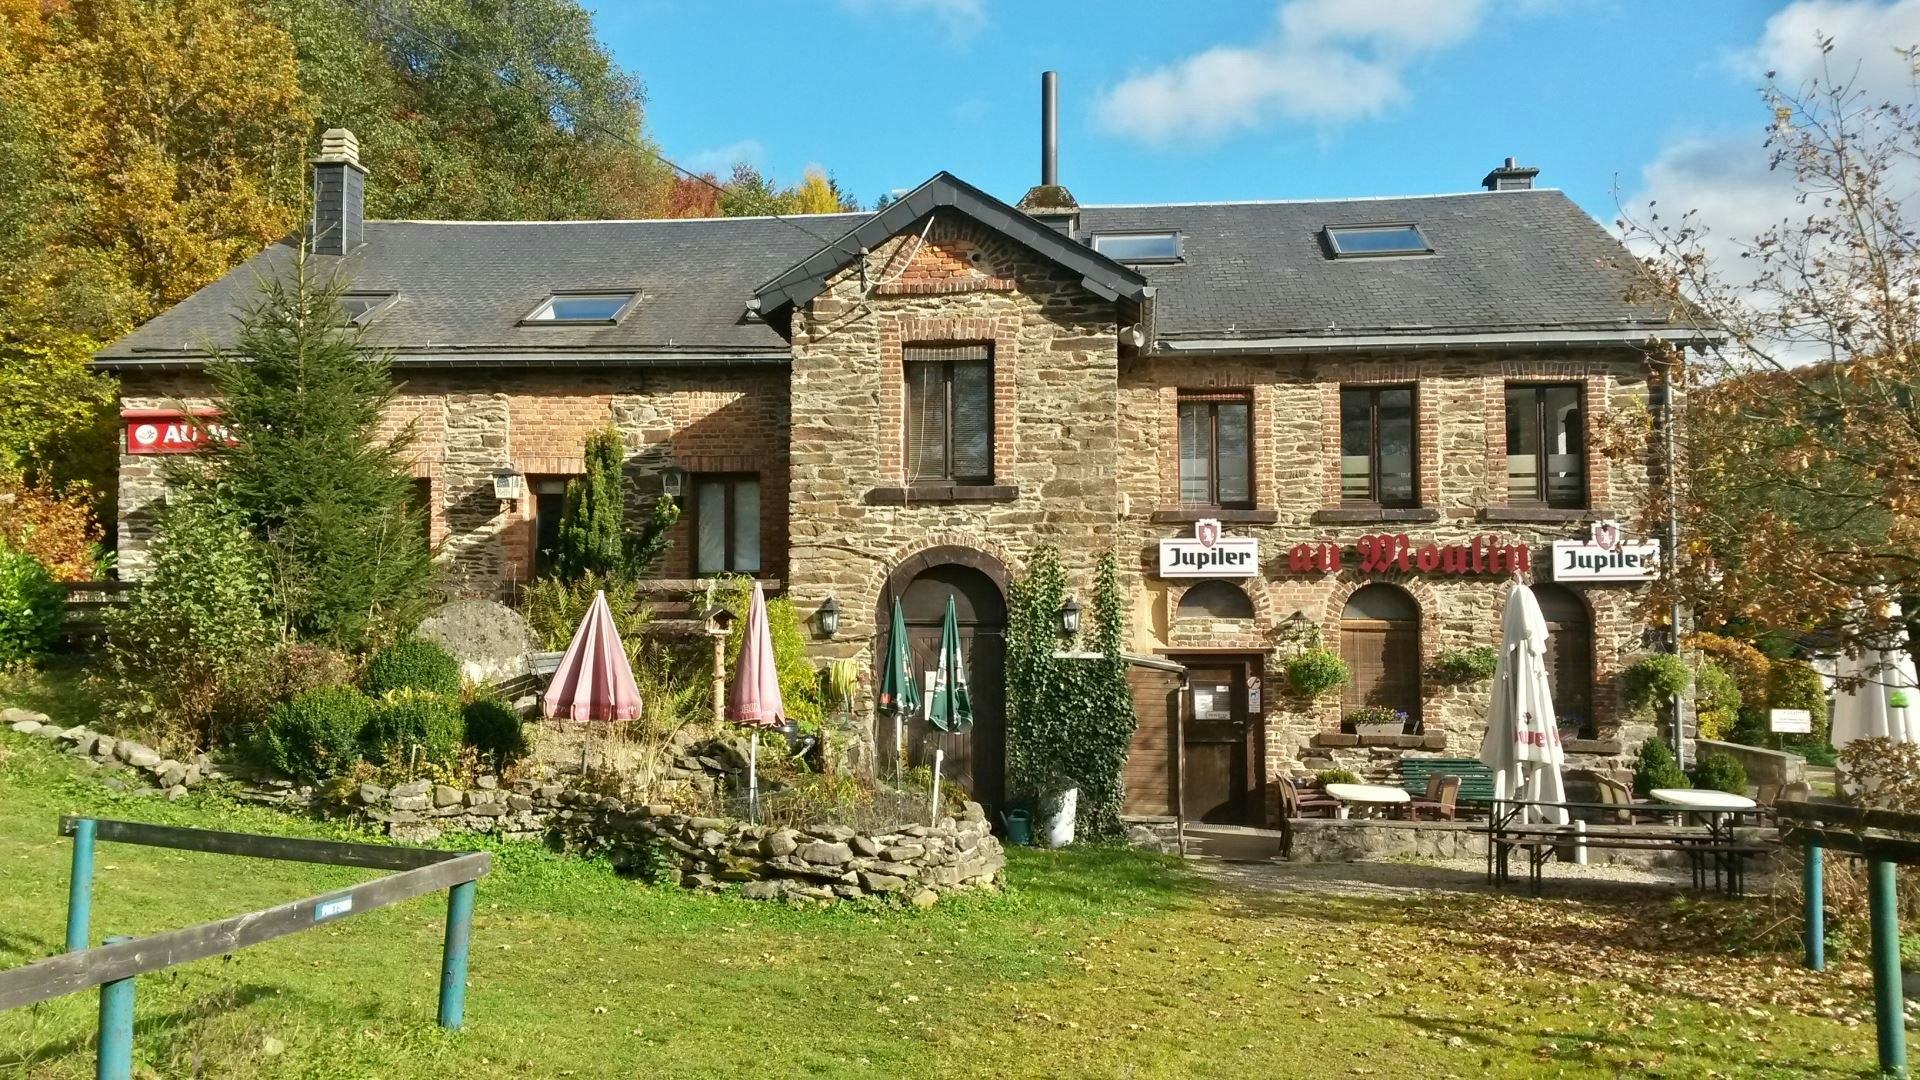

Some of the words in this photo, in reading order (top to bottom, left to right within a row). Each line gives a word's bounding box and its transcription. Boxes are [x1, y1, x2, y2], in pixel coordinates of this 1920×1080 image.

[163, 424, 198, 443] AU
[1169, 547, 1251, 570] Jupiler
[1289, 543, 1342, 573] au
[1357, 533, 1530, 574] Moulin
